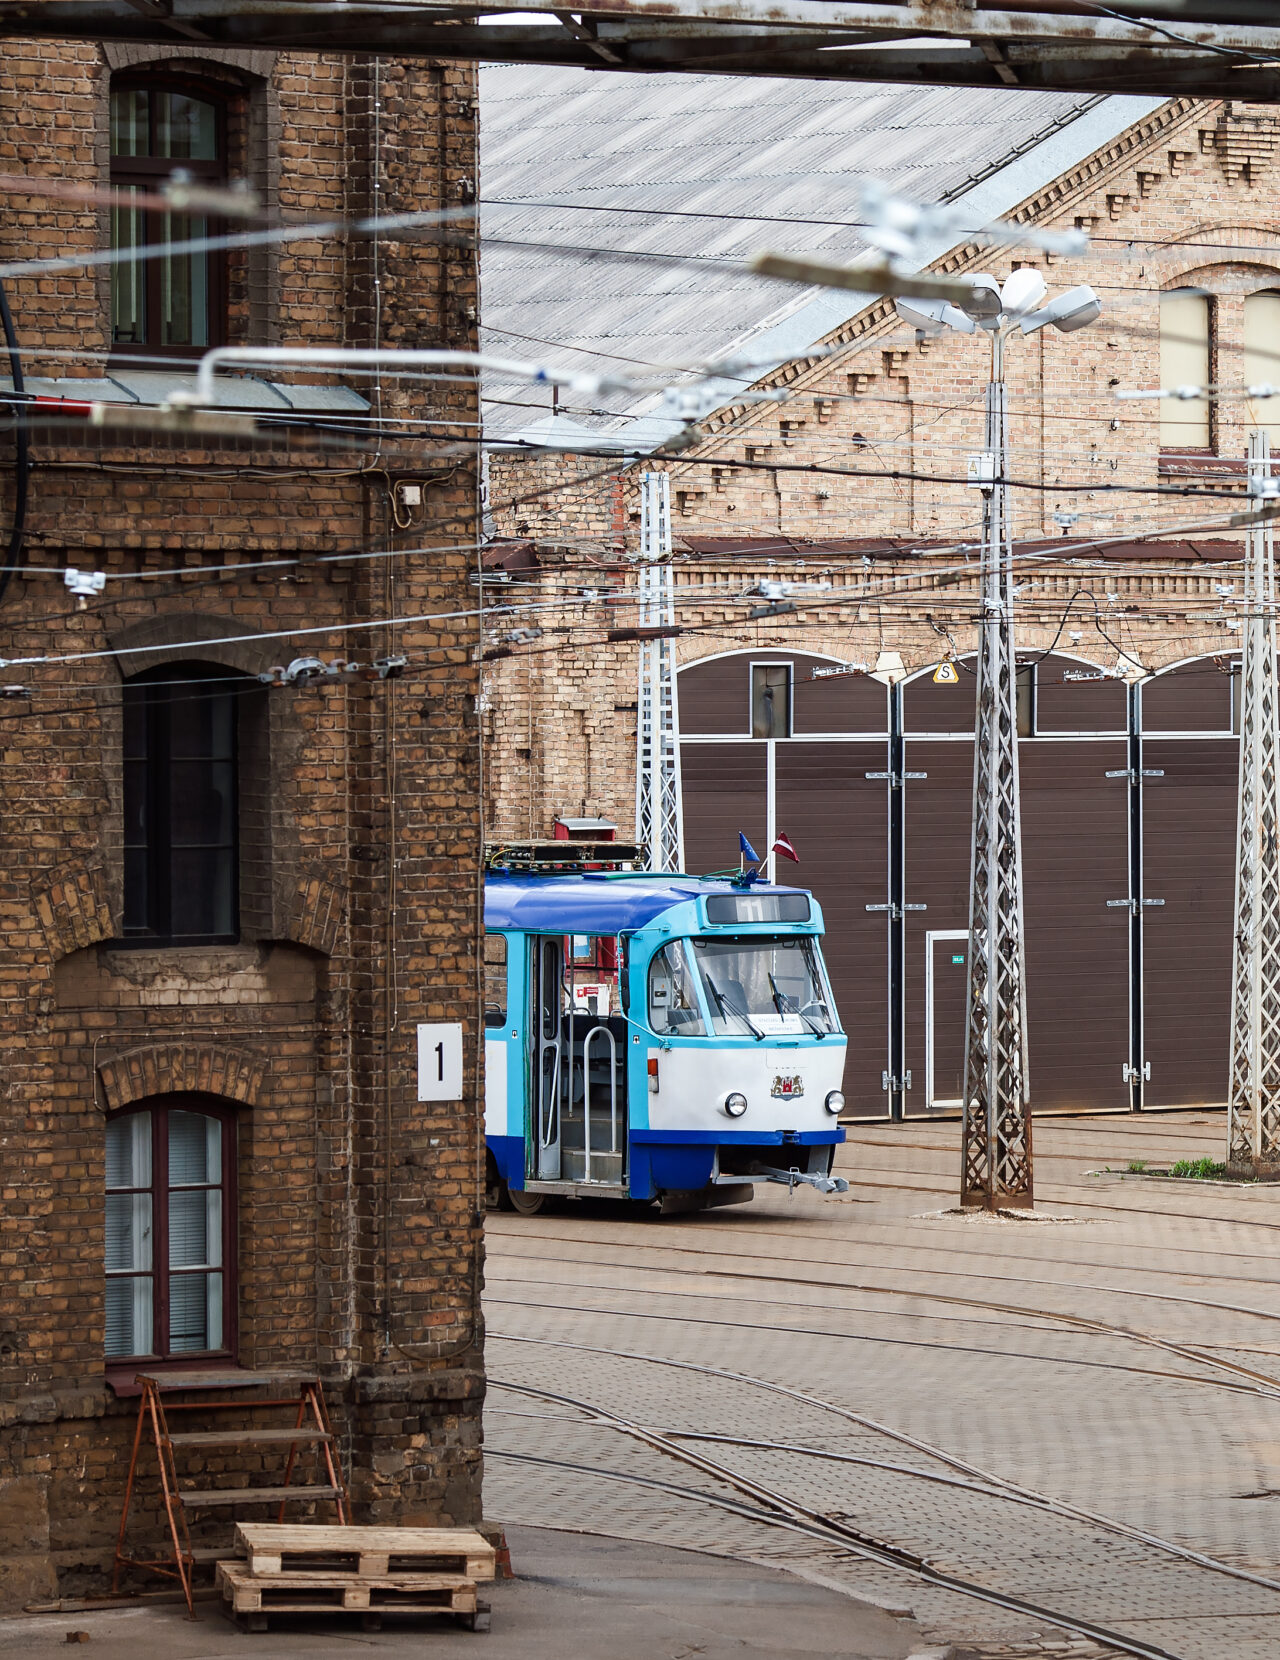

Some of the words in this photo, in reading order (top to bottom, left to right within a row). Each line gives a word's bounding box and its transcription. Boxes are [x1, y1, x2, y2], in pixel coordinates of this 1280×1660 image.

[941, 665, 950, 679] S
[740, 898, 764, 922] 11
[434, 1041, 443, 1081] 1
